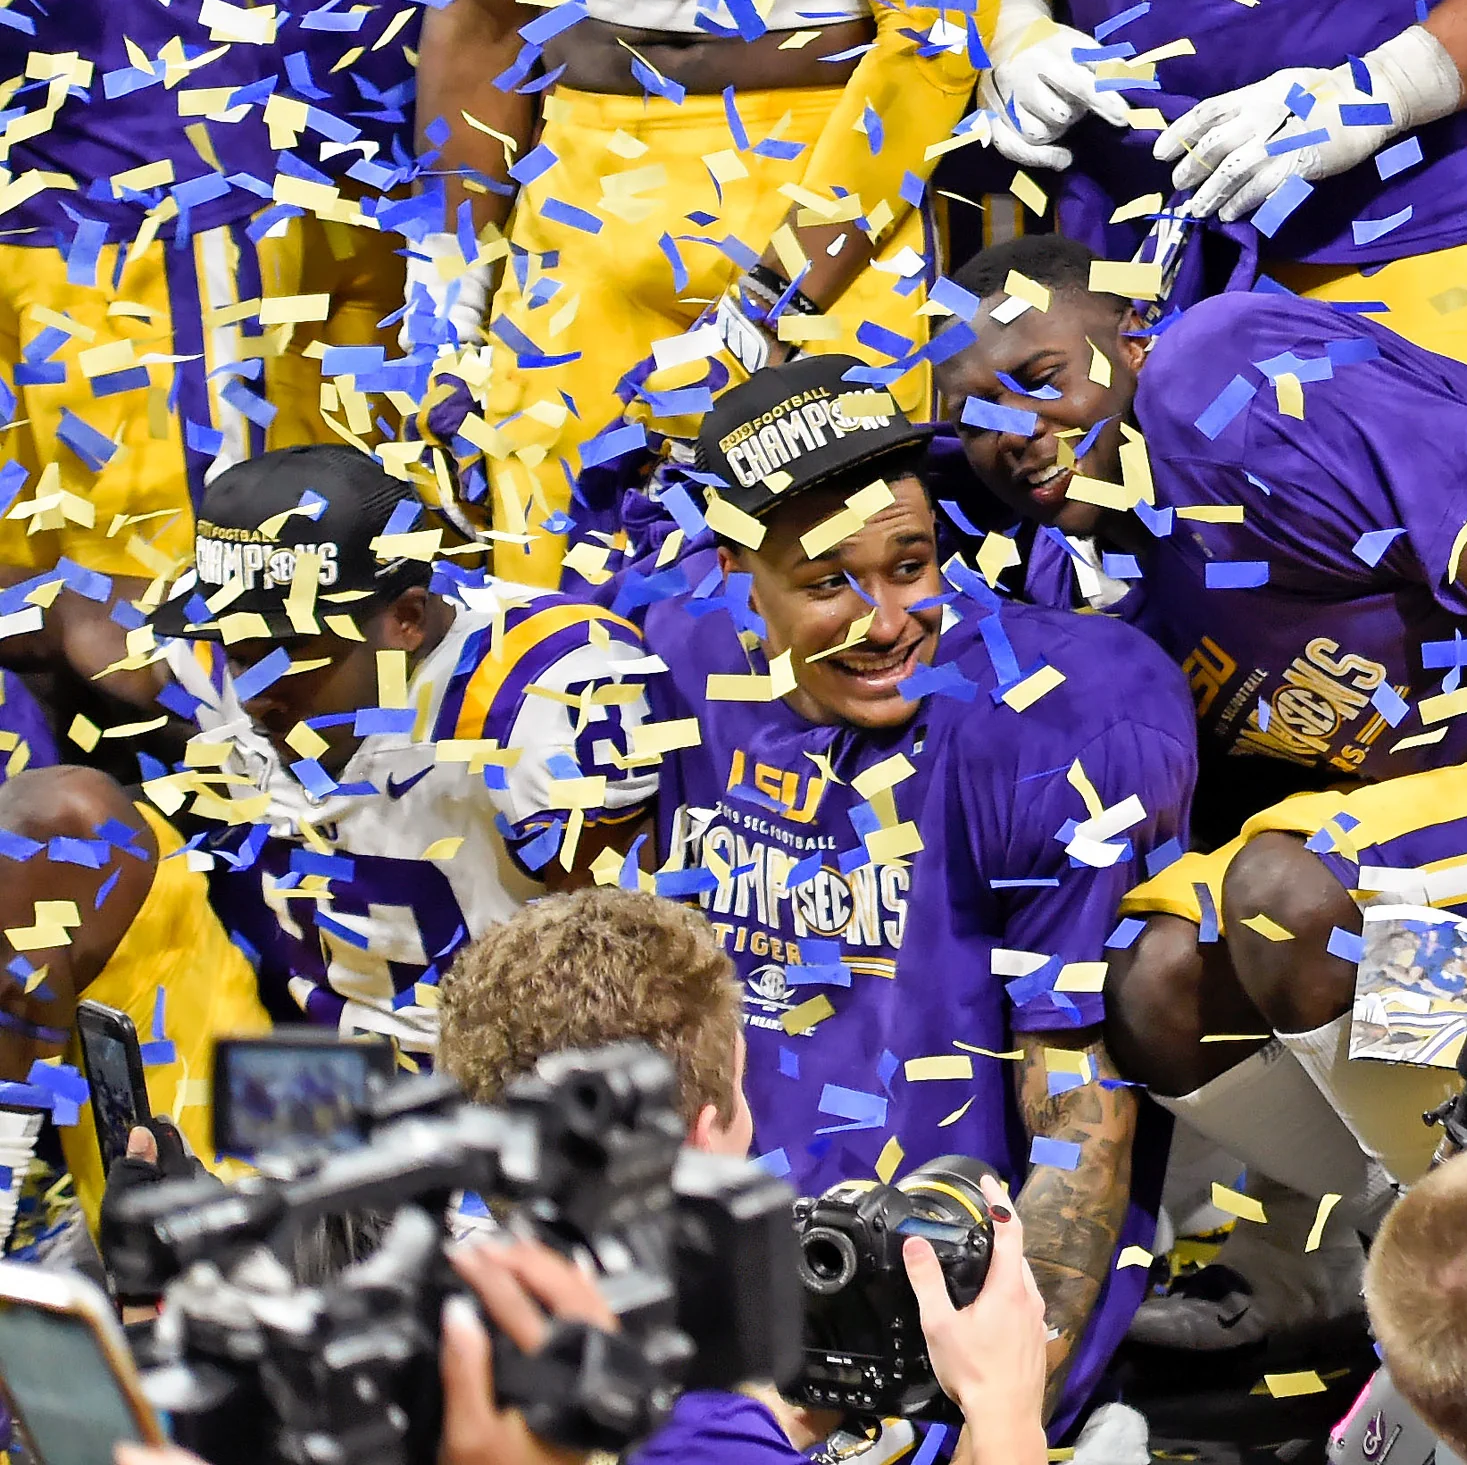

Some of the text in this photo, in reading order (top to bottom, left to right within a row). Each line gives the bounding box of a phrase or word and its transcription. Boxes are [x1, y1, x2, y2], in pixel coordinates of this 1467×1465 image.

[718, 386, 831, 454] 2019 FOOTBALL
[770, 826, 837, 851] FOOTBALL
[712, 922, 801, 965] TIGER
